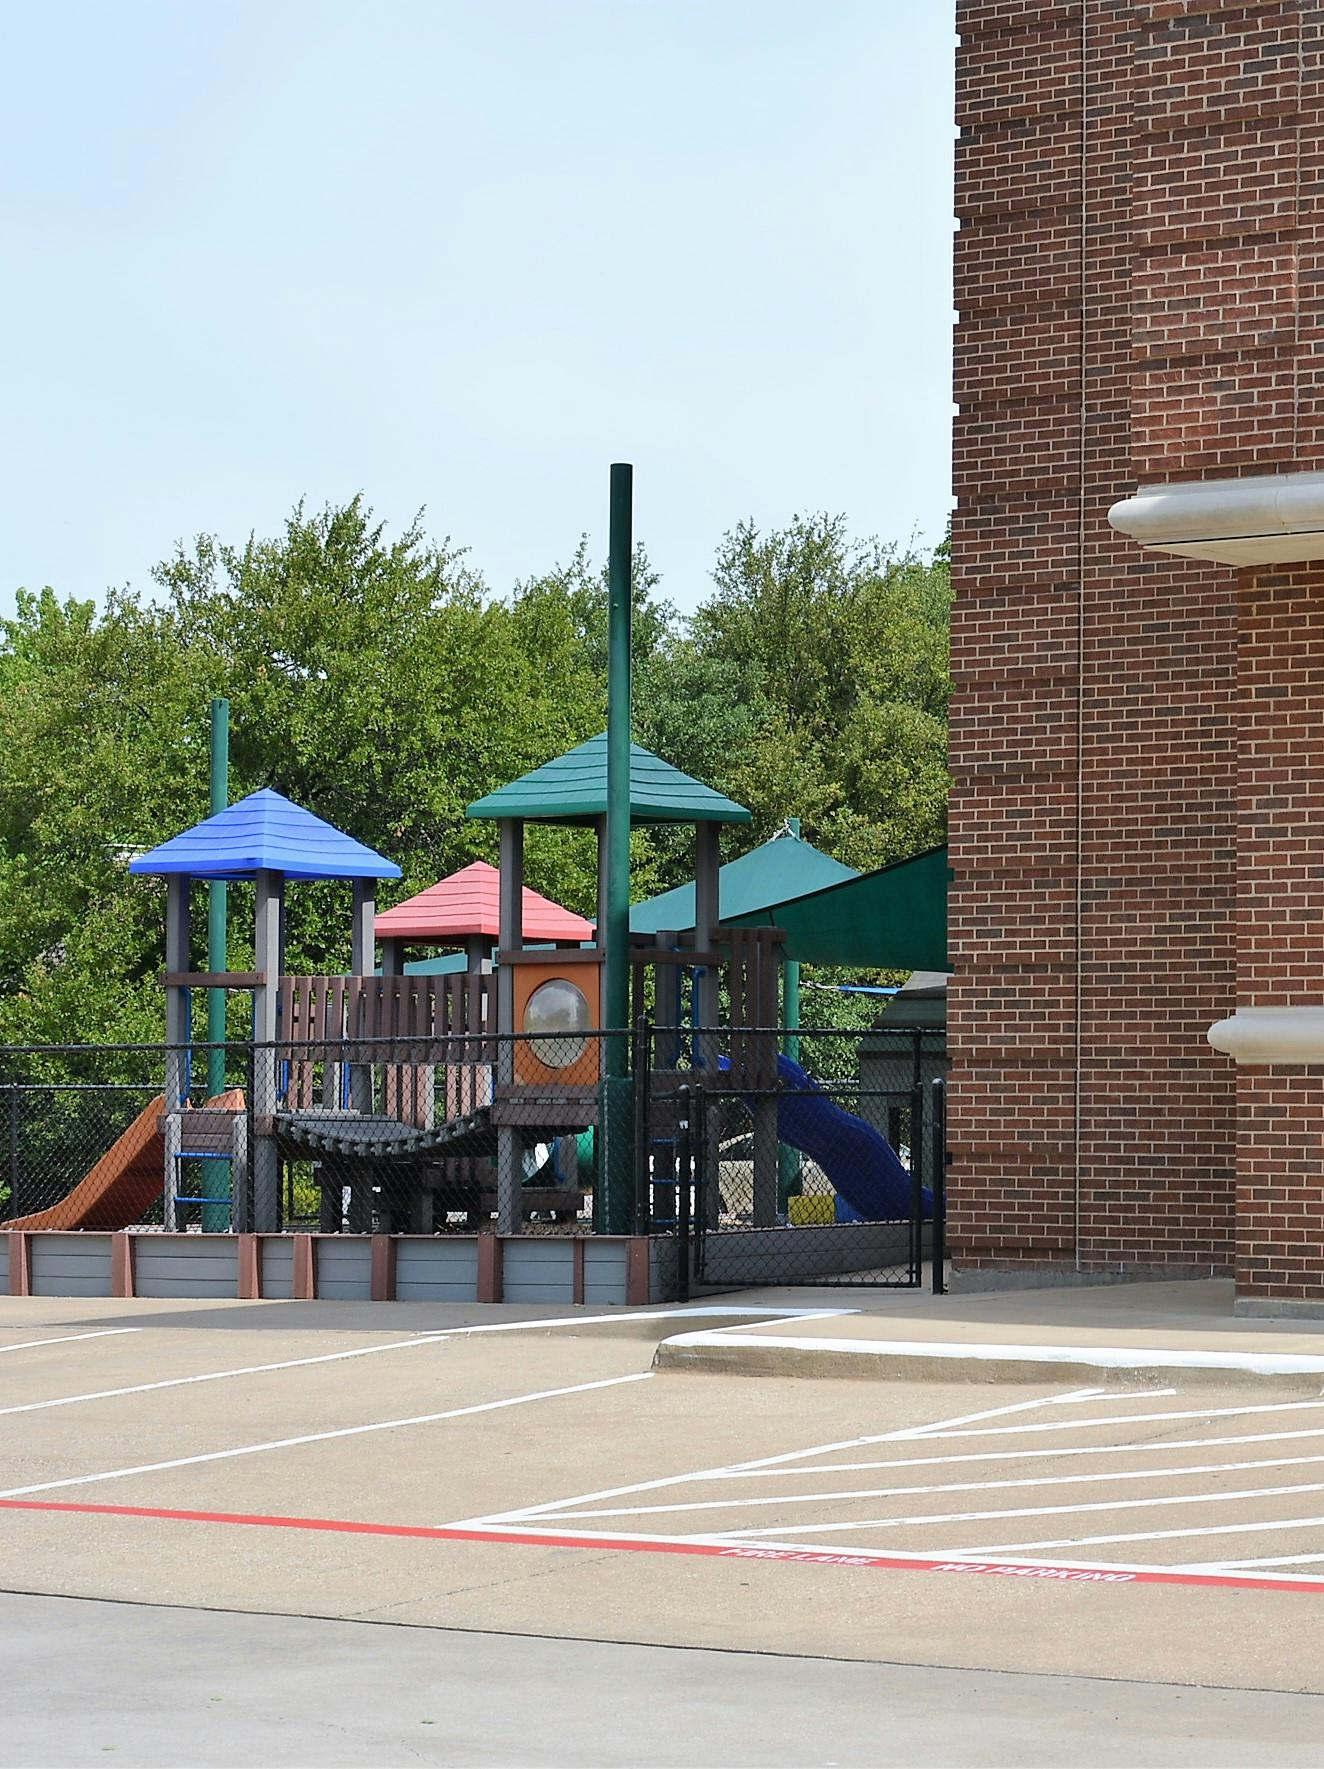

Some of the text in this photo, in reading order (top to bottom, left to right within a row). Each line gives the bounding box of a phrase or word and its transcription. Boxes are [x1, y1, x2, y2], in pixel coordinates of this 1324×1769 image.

[719, 1548, 879, 1566] FIRE LANE
[930, 1564, 1137, 1582] NO PARKING
